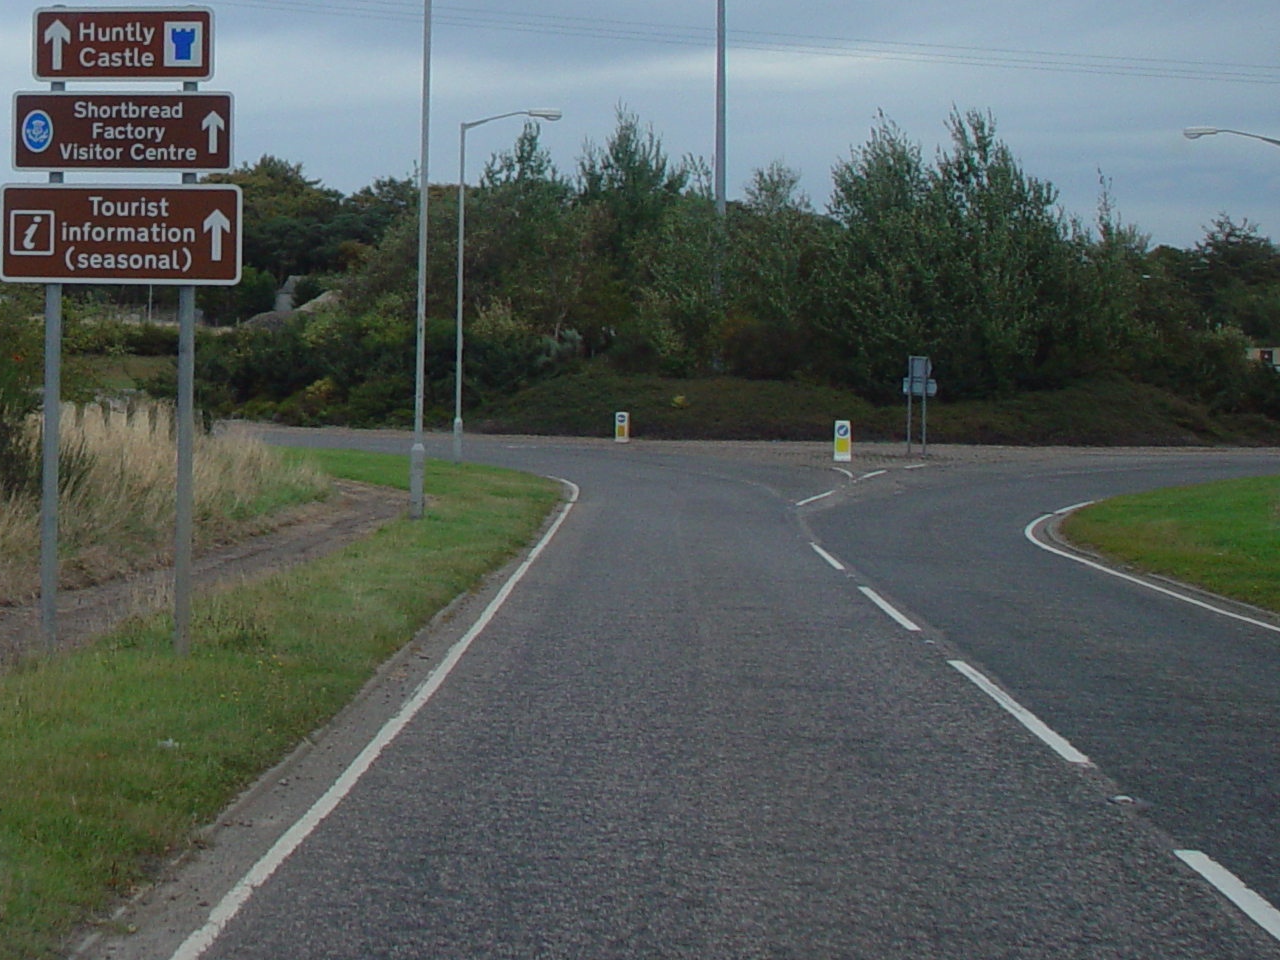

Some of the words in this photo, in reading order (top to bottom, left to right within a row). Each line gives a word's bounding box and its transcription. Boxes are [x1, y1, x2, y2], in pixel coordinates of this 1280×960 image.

[80, 23, 155, 45] Huntly
[80, 48, 154, 67] Castle
[74, 101, 183, 118] Shortbread
[92, 124, 165, 143] Factory
[60, 144, 123, 160] Visitor
[130, 144, 197, 161] Centre
[89, 196, 169, 217] Tourist
[62, 222, 195, 242] information
[65, 247, 192, 272] (seasonal)
